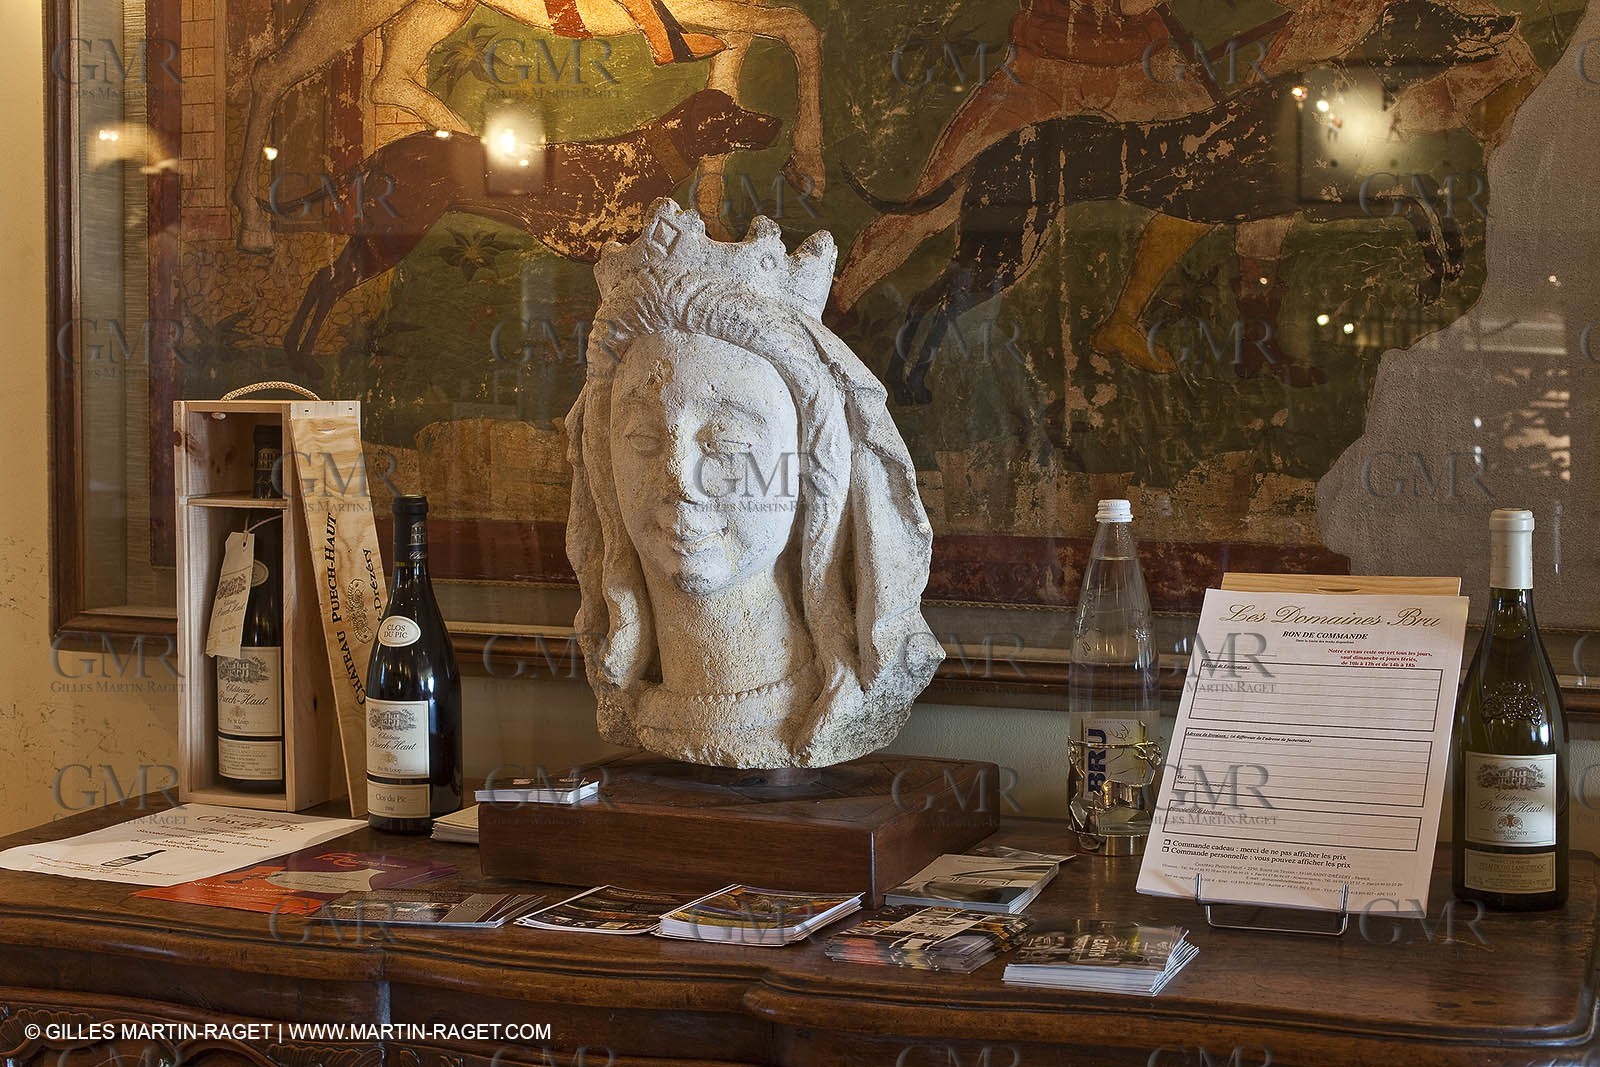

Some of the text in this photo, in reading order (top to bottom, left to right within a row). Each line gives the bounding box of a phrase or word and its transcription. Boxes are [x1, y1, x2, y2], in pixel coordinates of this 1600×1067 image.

[324, 512, 343, 624] PUECH-HAUT
[1219, 603, 1441, 628] Les Domaines Bru
[383, 631, 408, 639] DU PIC
[386, 624, 406, 632] CLOS
[1282, 629, 1369, 640] BON DE COMMANDE
[1088, 728, 1108, 794] BRU
[1170, 847, 1209, 857] Commande
[1209, 851, 1249, 861] personnelle
[1270, 856, 1296, 864] pouvez
[1297, 858, 1325, 867] afficher
[1325, 860, 1335, 868] les
[1336, 861, 1351, 869] prix
[1172, 840, 1210, 850] Commande
[1211, 843, 1235, 852] cadeau
[1240, 846, 1259, 854] merci
[1260, 846, 1270, 855] de
[1280, 849, 1292, 858] pas
[1293, 850, 1320, 859] afficher
[1321, 852, 1331, 860] les
[1332, 852, 1347, 862] prix
